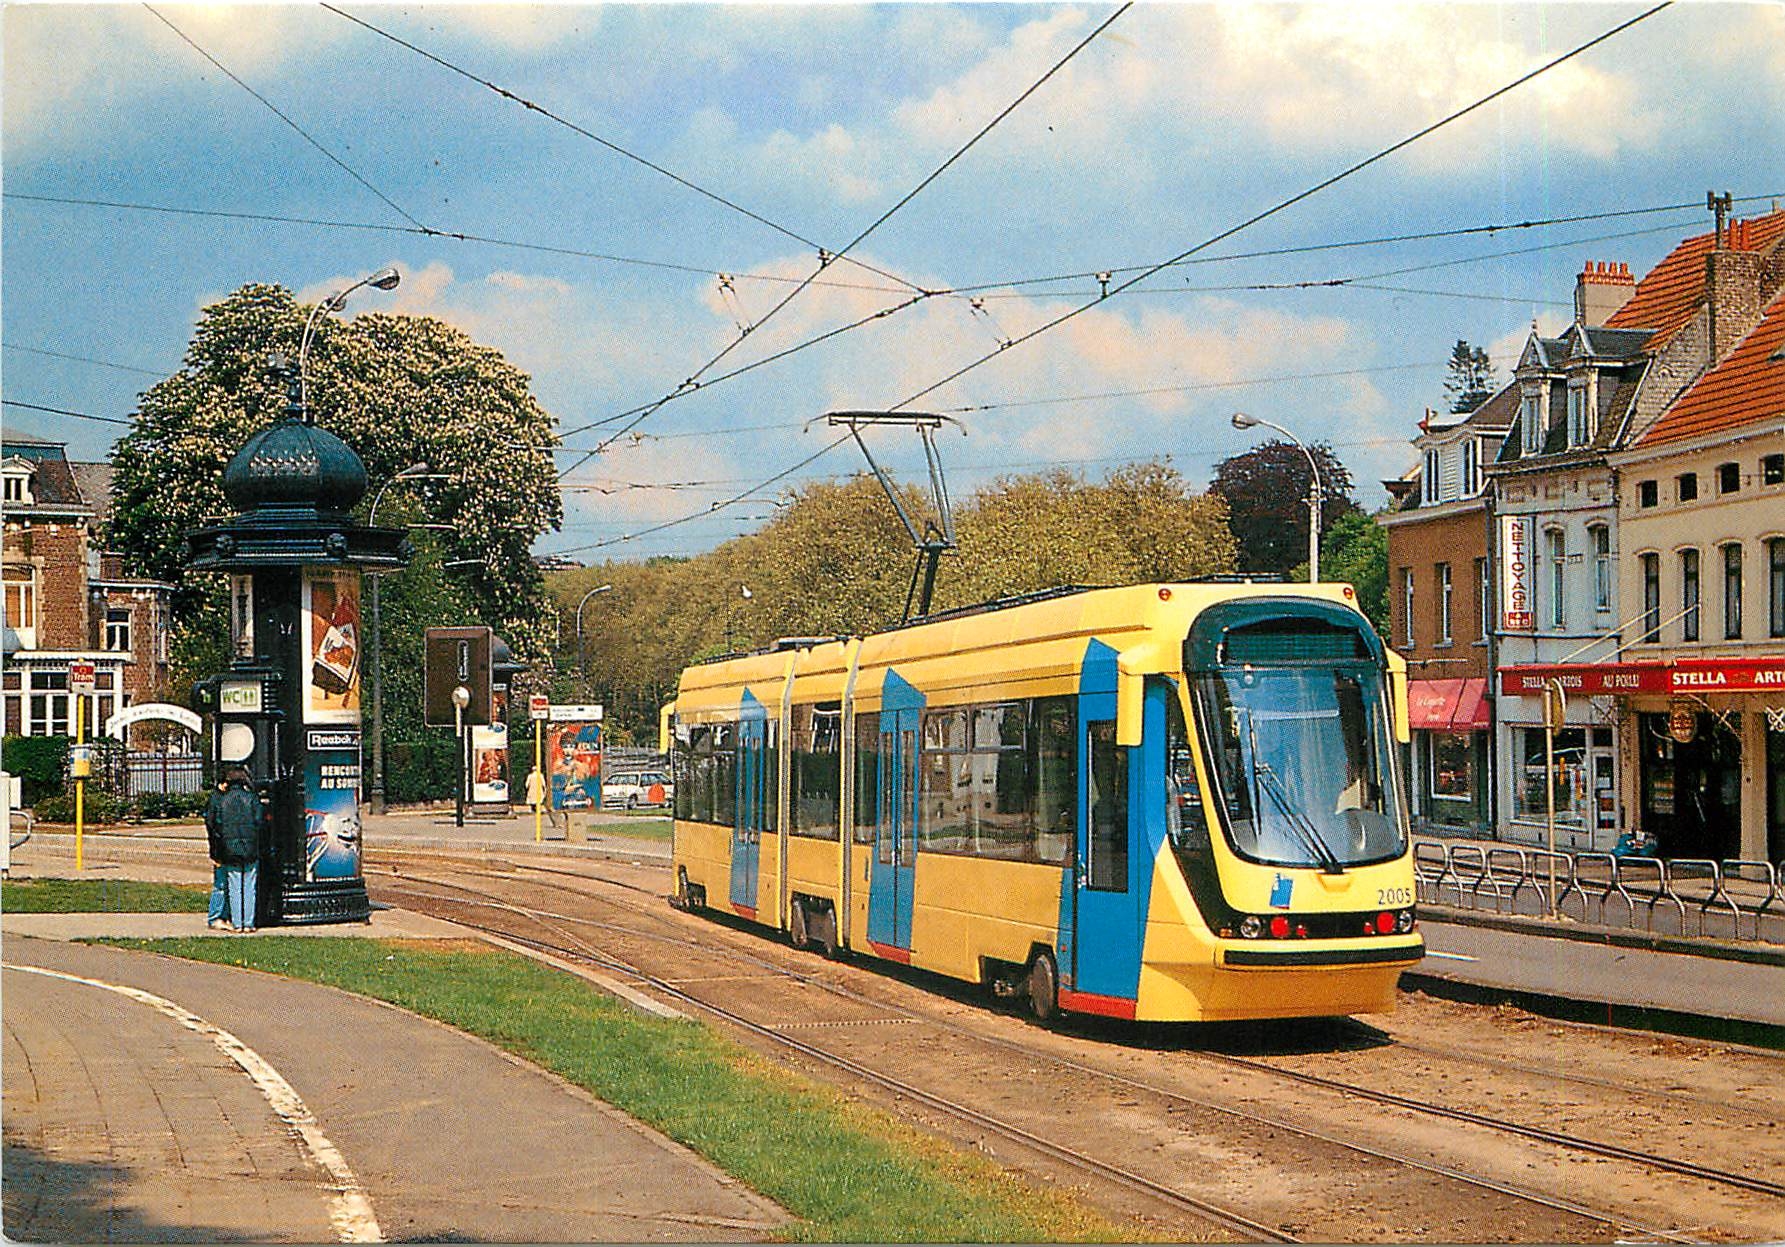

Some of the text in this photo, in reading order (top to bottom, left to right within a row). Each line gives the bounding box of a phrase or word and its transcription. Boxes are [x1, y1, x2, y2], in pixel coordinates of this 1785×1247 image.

[1511, 522, 1526, 610] NETTOYAGE
[73, 673, 94, 682] Tram
[1522, 675, 1546, 688] STELLA
[1672, 671, 1727, 685] STELLA
[223, 690, 240, 704] WC
[311, 735, 352, 746] Reebok
[320, 778, 335, 789] AU
[1377, 887, 1412, 905] 2005
